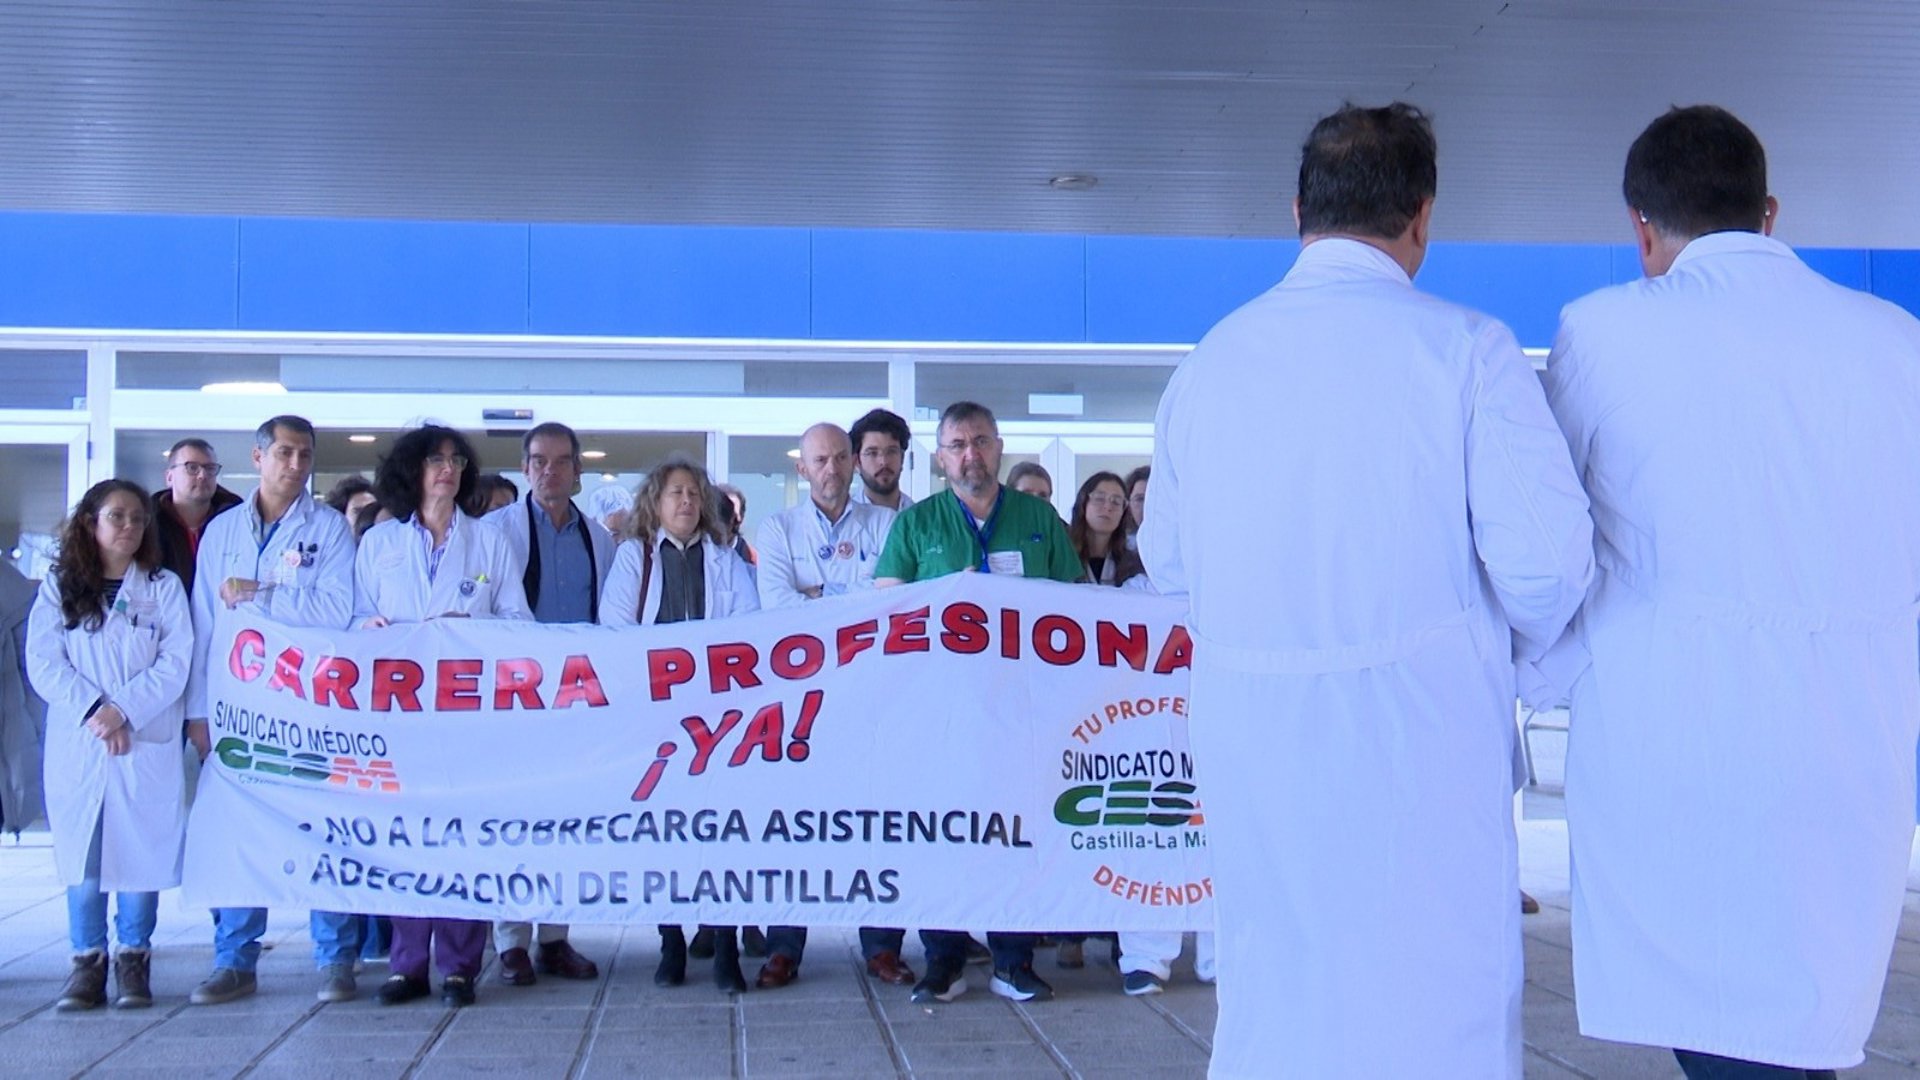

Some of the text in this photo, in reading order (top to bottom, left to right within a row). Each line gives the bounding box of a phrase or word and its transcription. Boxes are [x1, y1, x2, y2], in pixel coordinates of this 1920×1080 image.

[229, 628, 609, 712] CARRERA
[215, 701, 387, 757] SINDICATO MÉDICO
[630, 689, 824, 802] ¡YA!
[1072, 697, 1189, 744] TU PROFE
[1062, 749, 1175, 781] SINDICATO
[325, 809, 1033, 848] NO A LA SOBRECARGA ASISTENCIAL
[1071, 831, 1177, 850] Castilla-La
[309, 852, 900, 906] ADECUACIÓN DE PLANTILLAS
